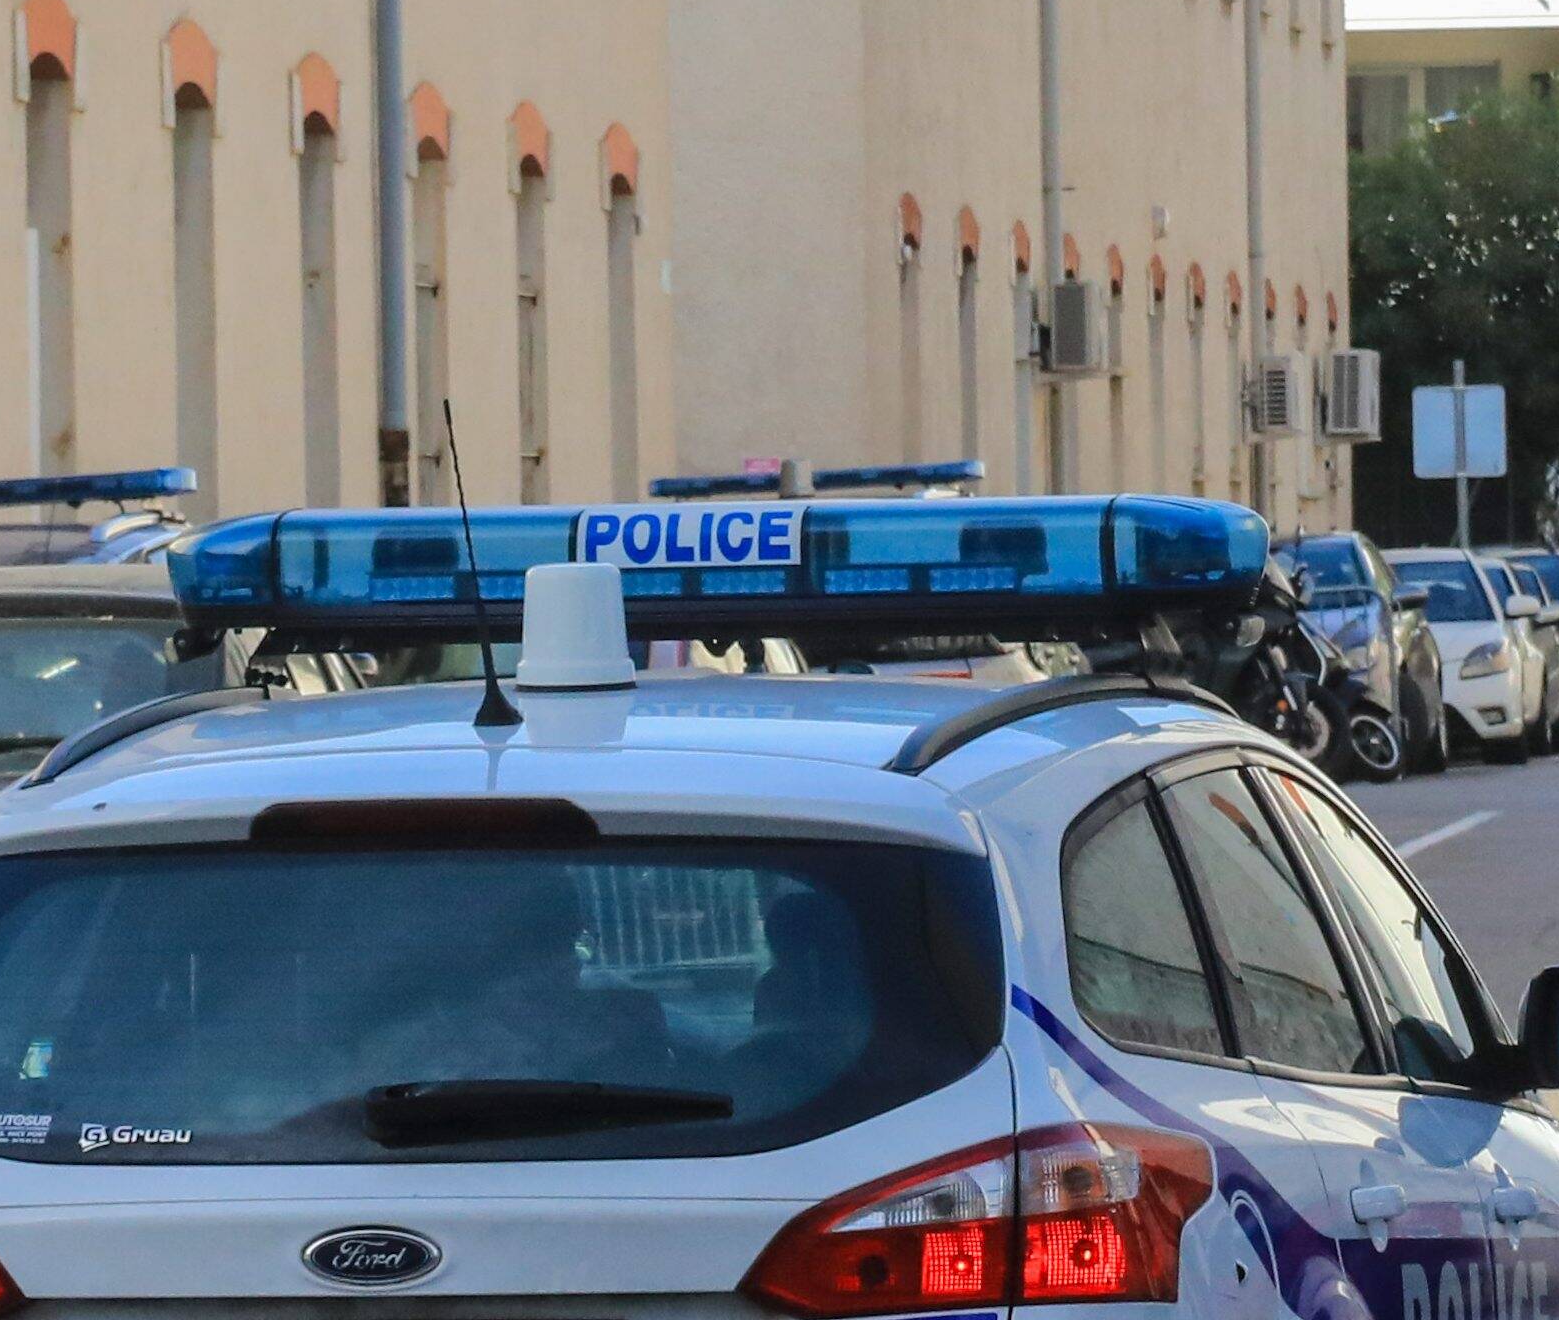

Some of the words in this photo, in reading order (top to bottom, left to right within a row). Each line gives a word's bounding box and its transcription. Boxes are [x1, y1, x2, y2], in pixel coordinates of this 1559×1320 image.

[585, 510, 794, 565] POLICE
[112, 1125, 191, 1143] Gruau
[331, 1239, 407, 1269] Ford
